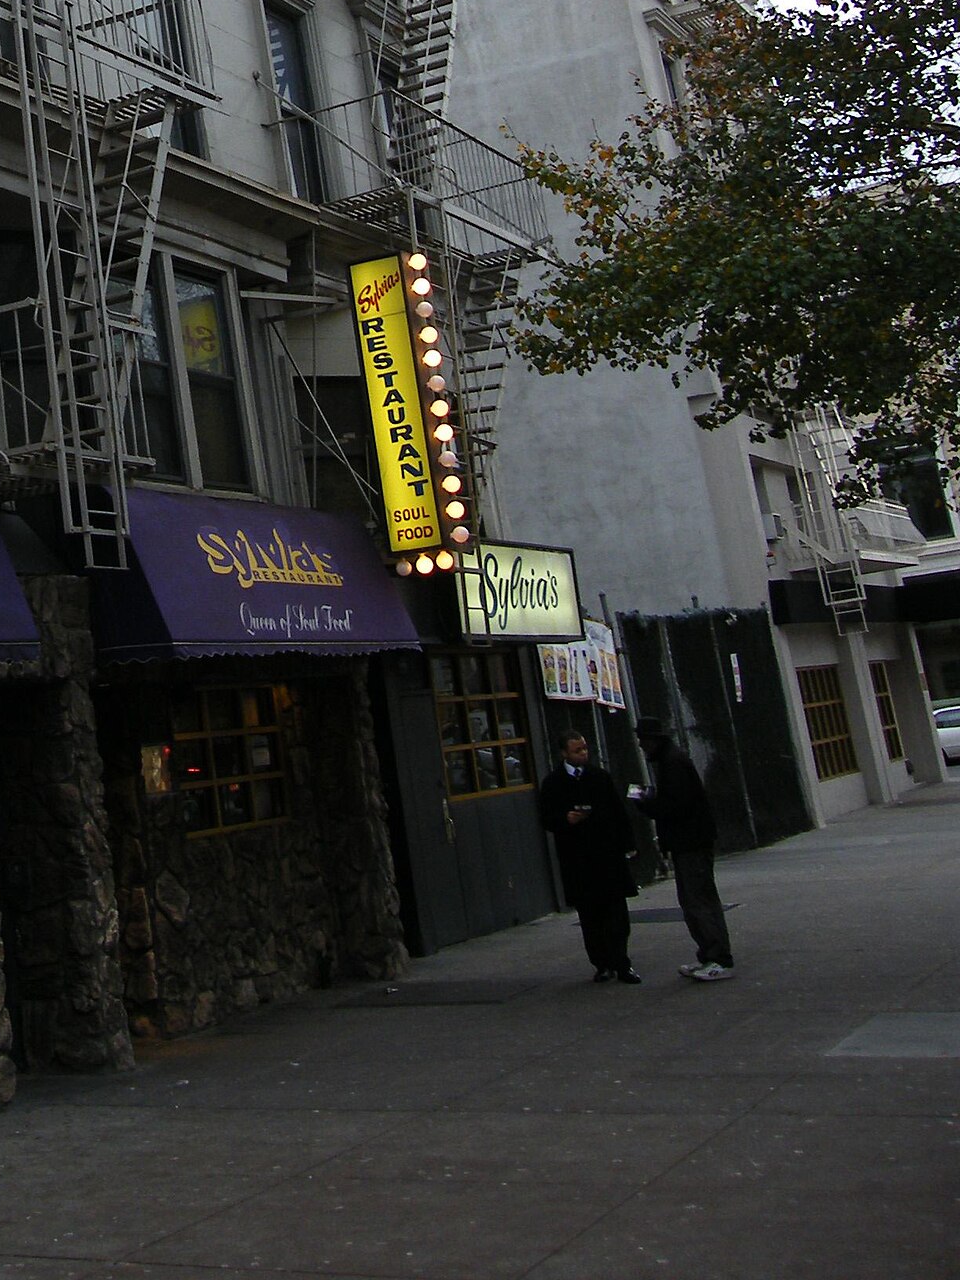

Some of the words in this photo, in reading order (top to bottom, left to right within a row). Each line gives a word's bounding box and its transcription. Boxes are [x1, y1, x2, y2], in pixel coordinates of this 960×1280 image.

[361, 317, 428, 496] RESTAURANT
[393, 506, 431, 523] SOUL
[396, 525, 434, 543] FOOD
[252, 570, 340, 586] RESTAURANT
[479, 552, 559, 631] Sylvia's
[239, 601, 277, 636] Queen
[279, 603, 292, 639] of
[292, 604, 319, 632] Soul
[320, 604, 353, 631] Food
